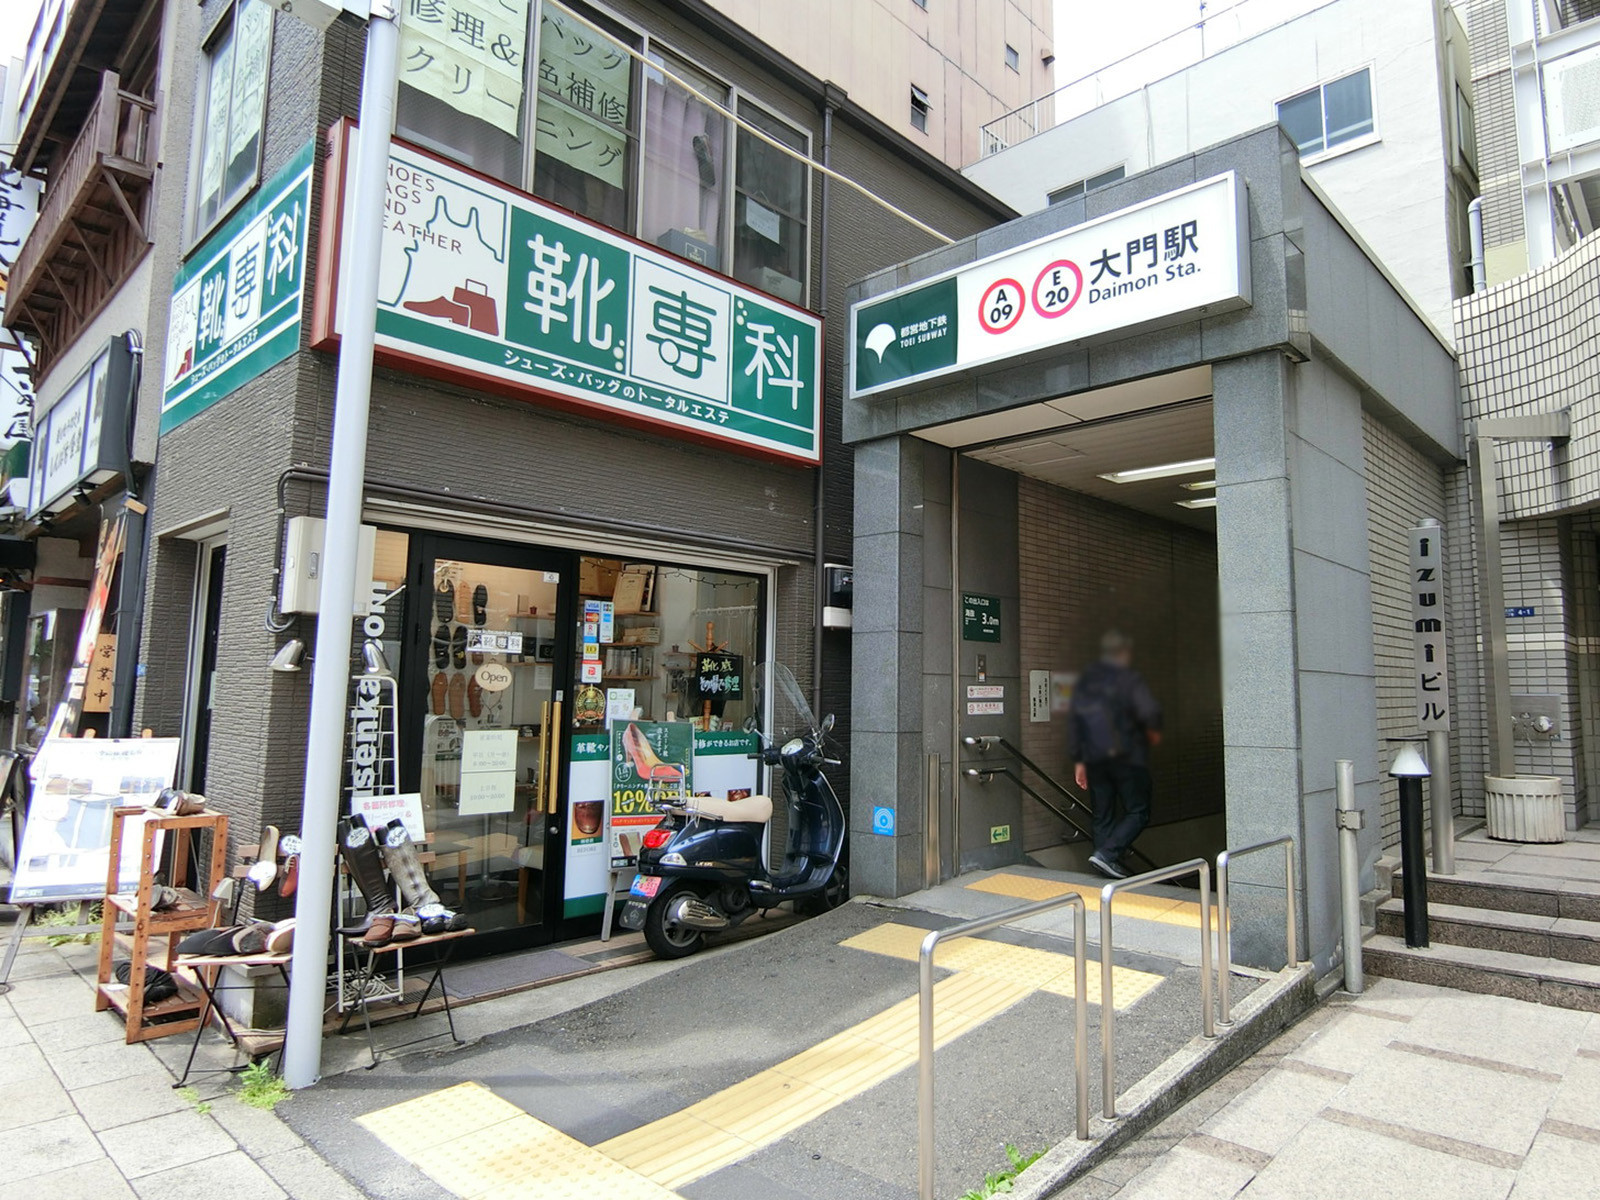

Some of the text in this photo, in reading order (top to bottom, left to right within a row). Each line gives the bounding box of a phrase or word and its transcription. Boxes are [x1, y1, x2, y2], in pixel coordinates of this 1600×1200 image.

[542, 15, 629, 70] バッグ
[406, 45, 516, 110] クリー
[538, 58, 626, 126] 色補修
[535, 116, 622, 167] ニング
[386, 163, 435, 193] HOES
[383, 214, 462, 255] EATHER
[1089, 219, 1199, 286] 大門駅
[198, 200, 300, 350] 靴専科
[995, 288, 1008, 303] A
[1052, 269, 1062, 286] E
[1088, 261, 1202, 305] Daimon Sta.
[989, 304, 1014, 324] 09
[1045, 286, 1070, 308] 20
[523, 233, 806, 411] 靴専科
[900, 314, 948, 339] 都営地下鉄
[900, 326, 948, 349] TOEI SUBWAY
[504, 348, 730, 424] シューズ・バッグのトータルエステ
[981, 612, 1000, 626] 3.0m
[93, 644, 116, 704] 営業中
[480, 670, 508, 685] Open
[613, 790, 655, 814] 10%
